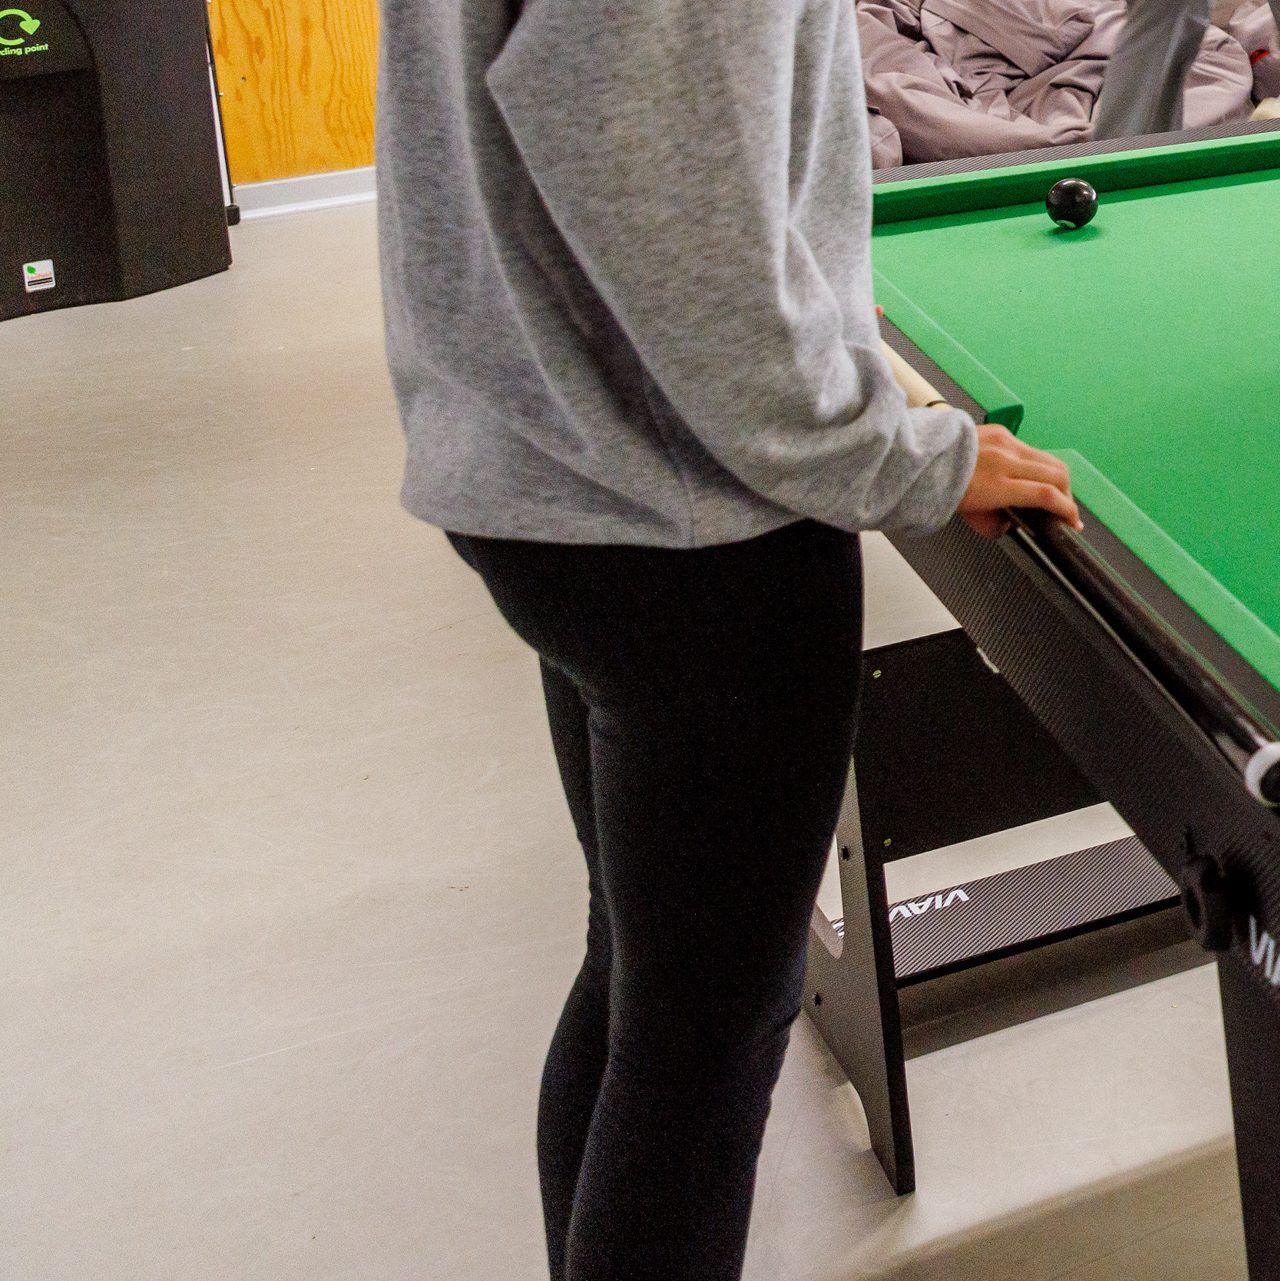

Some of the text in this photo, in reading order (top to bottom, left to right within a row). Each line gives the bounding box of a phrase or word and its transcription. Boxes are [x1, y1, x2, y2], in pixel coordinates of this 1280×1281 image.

[0, 43, 49, 56] cling point
[888, 889, 970, 923] VIAV
